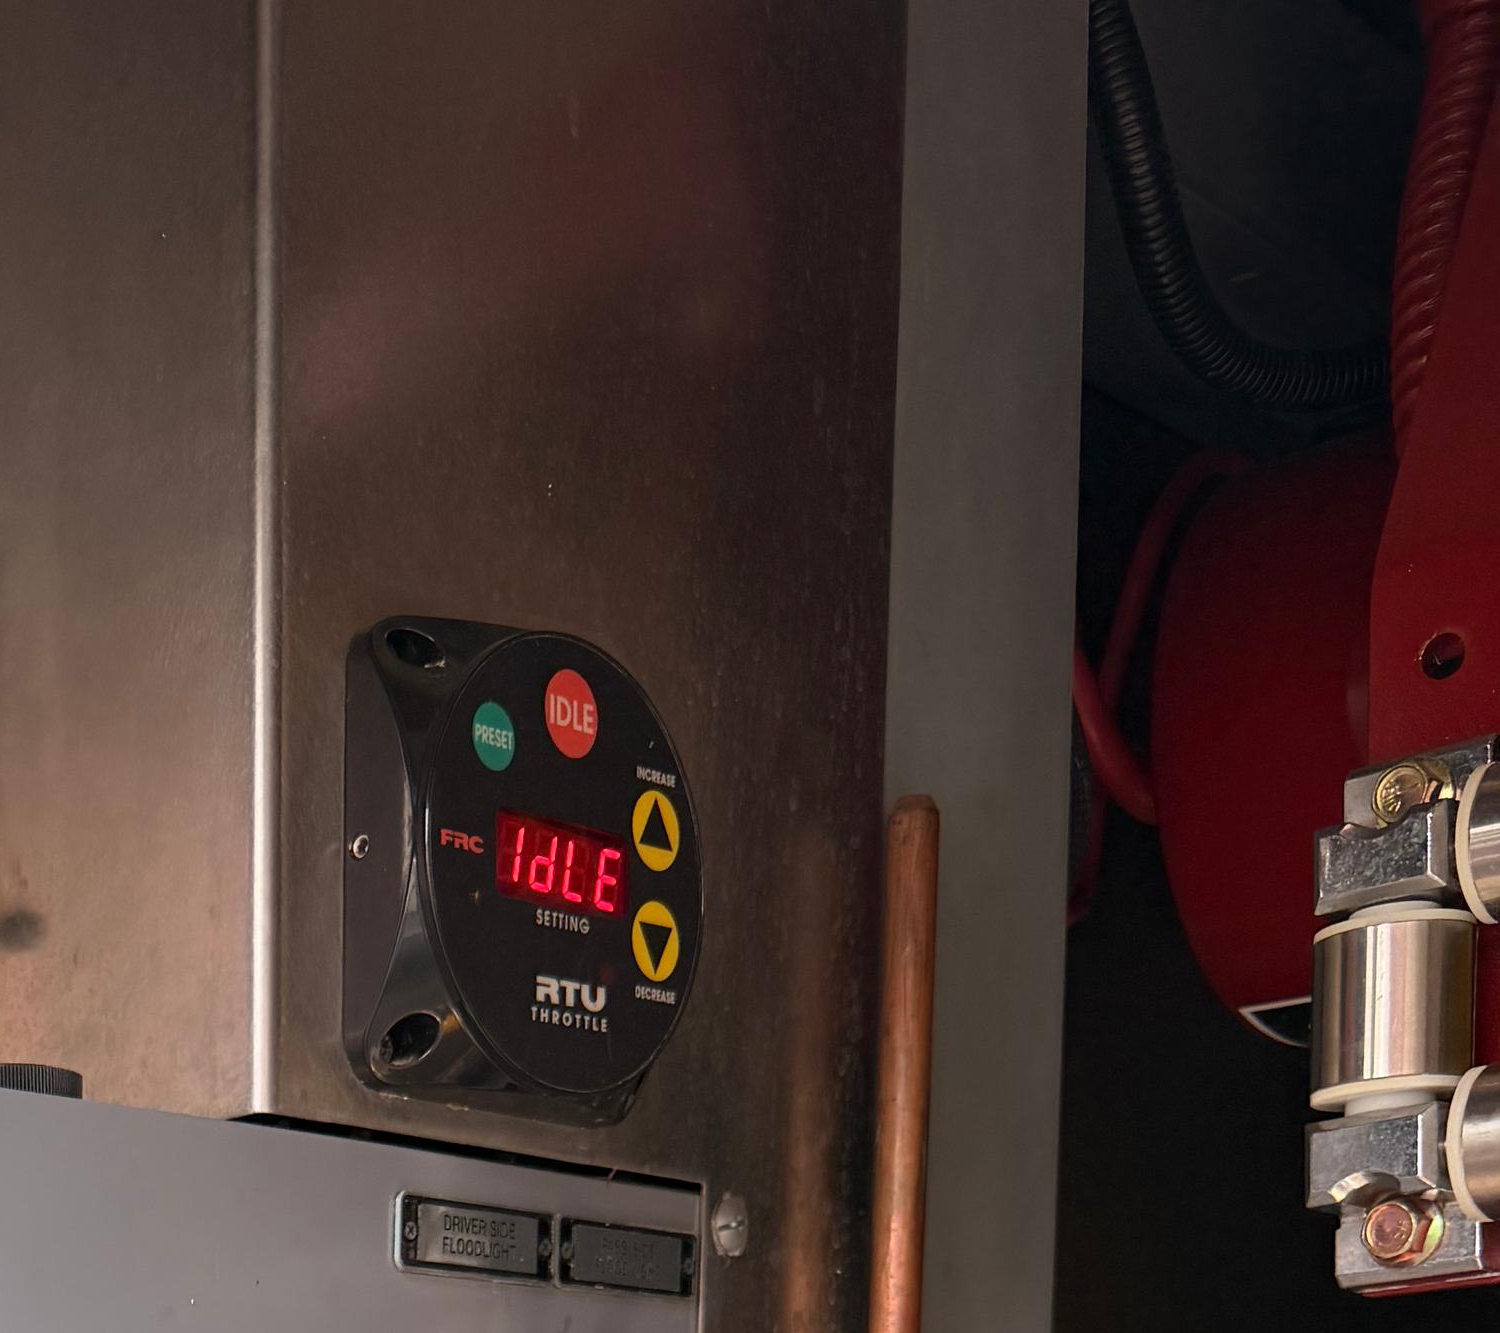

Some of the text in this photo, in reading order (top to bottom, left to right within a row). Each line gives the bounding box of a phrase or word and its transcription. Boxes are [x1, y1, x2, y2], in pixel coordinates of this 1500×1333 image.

[548, 694, 595, 734] IDLE
[474, 725, 512, 750] PRESET
[636, 766, 676, 788] INCREASE
[440, 829, 484, 853] FRC
[536, 909, 590, 934] SETTING
[536, 976, 607, 1012] RTU
[635, 985, 676, 1004] DECREASE
[531, 1006, 608, 1032] THROTTLE
[444, 1215, 516, 1239] DRIVER SIDE
[442, 1237, 516, 1260] FLOODLIGHT
